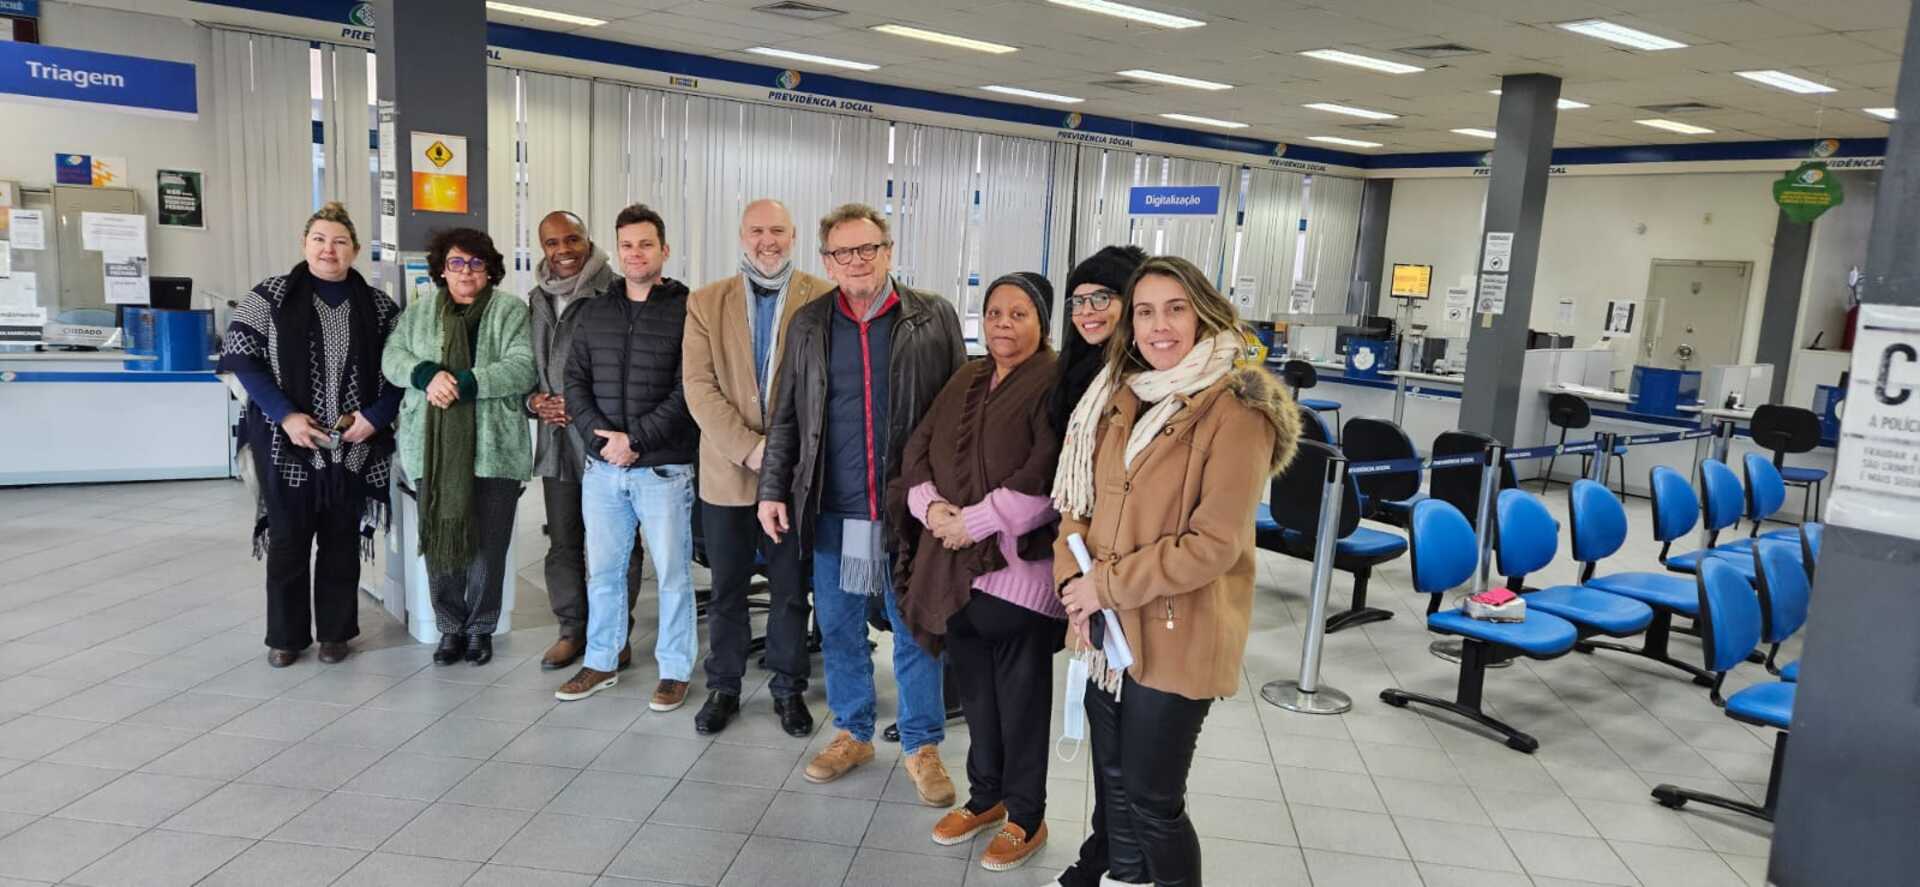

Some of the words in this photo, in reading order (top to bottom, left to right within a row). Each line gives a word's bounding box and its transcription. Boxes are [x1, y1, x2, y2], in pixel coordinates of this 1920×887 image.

[26, 60, 125, 88] Triagem
[768, 90, 837, 108] PREVIDÊNCIA
[839, 101, 874, 113] SOCIAL
[1057, 131, 1107, 144] PREVIDÊNCIA
[1108, 137, 1134, 148] SOCIAL
[1145, 194, 1201, 207] Digitalização
